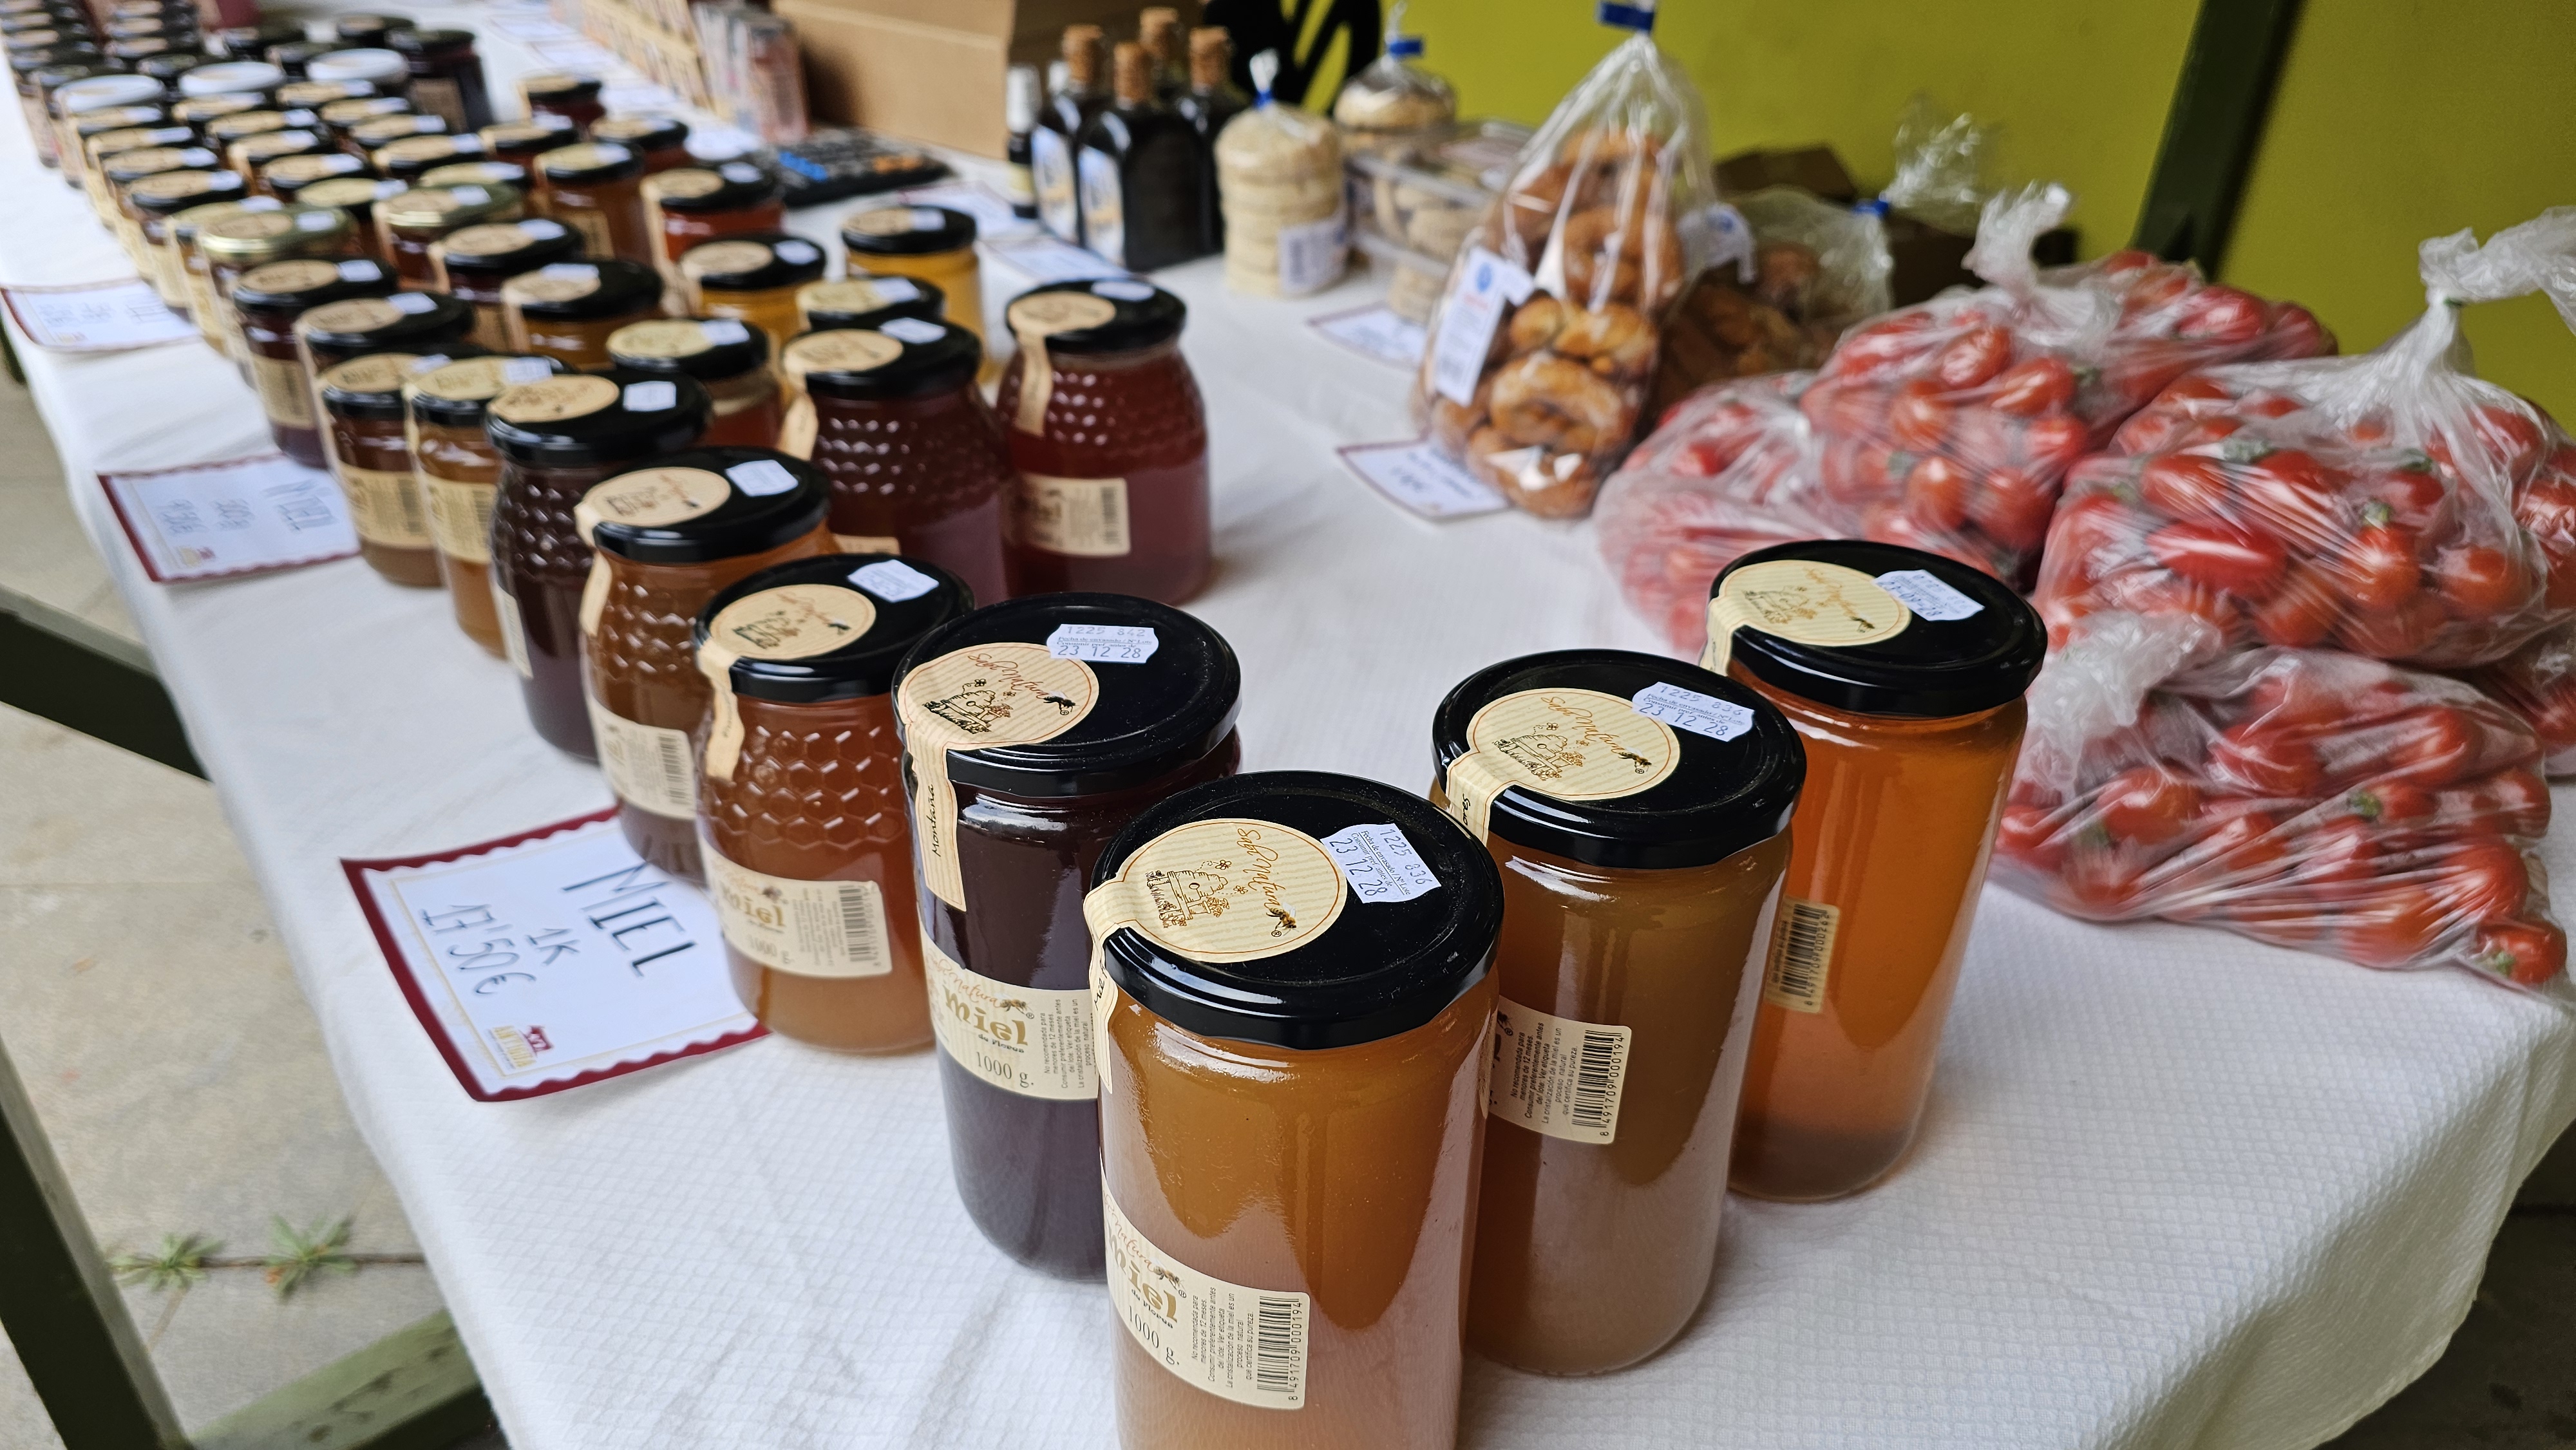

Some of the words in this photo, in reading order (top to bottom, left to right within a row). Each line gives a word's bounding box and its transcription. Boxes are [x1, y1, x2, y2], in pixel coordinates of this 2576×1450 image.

[1117, 628, 1145, 637] 842
[1057, 645, 1079, 655] 23
[1092, 646, 1110, 657] 12
[1121, 647, 1141, 659] 28
[1660, 686, 1702, 702] 1225
[1711, 701, 1744, 716] 836
[1639, 702, 1665, 716] 23
[1674, 712, 1697, 727] 12
[1703, 722, 1728, 736] 28
[926, 784, 941, 858] Montaña
[1329, 838, 1358, 854] 23
[1351, 833, 1371, 855] Consumir
[1376, 867, 1388, 880] antes
[1361, 830, 1374, 845] Fecha
[1376, 851, 1396, 873] envasado
[1379, 829, 1412, 856] 1225
[1405, 863, 1432, 885] 836
[1345, 858, 1374, 876] 12
[1358, 880, 1388, 896] 28
[560, 860, 696, 977] MIEL
[1064, 1015, 1073, 1038] etiqueta
[1041, 1027, 1050, 1064] recomendada
[1541, 1043, 1550, 1068] etiqueta
[1549, 1067, 1557, 1075] de
[1555, 1028, 1562, 1036] un
[976, 1051, 1012, 1079] 1000
[1513, 1047, 1524, 1088] recomendada
[1522, 1065, 1530, 1074] de
[1524, 1089, 1535, 1118] Consumir
[1530, 1040, 1542, 1091] preferentemente
[1536, 1022, 1544, 1040] antes
[1539, 1068, 1547, 1079] Ver
[1602, 1082, 1616, 1123] 491709
[1609, 1037, 1624, 1077] 000194
[1520, 1075, 1528, 1101] menores
[1555, 1078, 1564, 1104] proceso
[1229, 1293, 1235, 1301] un
[1130, 1305, 1159, 1348] 1000
[1200, 1329, 1207, 1337] de
[1208, 1304, 1217, 1355] preferentemente
[1218, 1308, 1226, 1332] etiqueta
[1291, 1303, 1302, 1343] 000194
[1289, 1348, 1300, 1388] 491709
